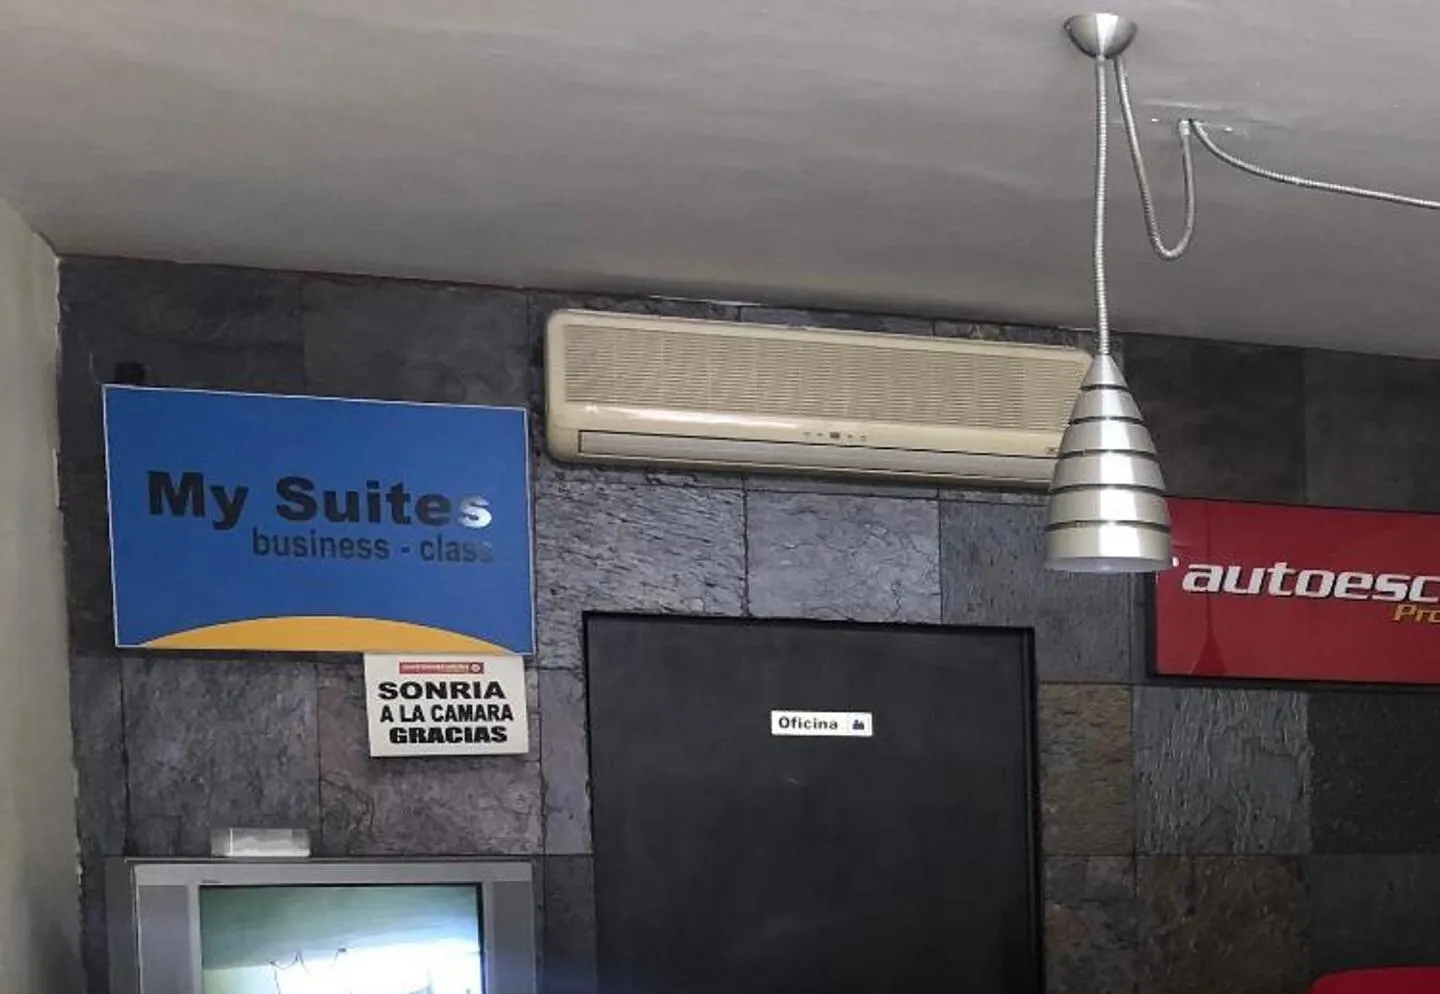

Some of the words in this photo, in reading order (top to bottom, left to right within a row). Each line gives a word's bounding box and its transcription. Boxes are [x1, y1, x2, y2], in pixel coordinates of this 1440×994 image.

[147, 470, 249, 531] My
[275, 475, 493, 529] Suites
[252, 526, 391, 560] business
[419, 533, 494, 563] class
[377, 680, 506, 700] SONRIA
[379, 704, 394, 723] A
[400, 703, 426, 723] LA
[430, 703, 514, 722] CAMARA
[778, 715, 838, 730] Oficina
[389, 725, 508, 744] GRACIAS
